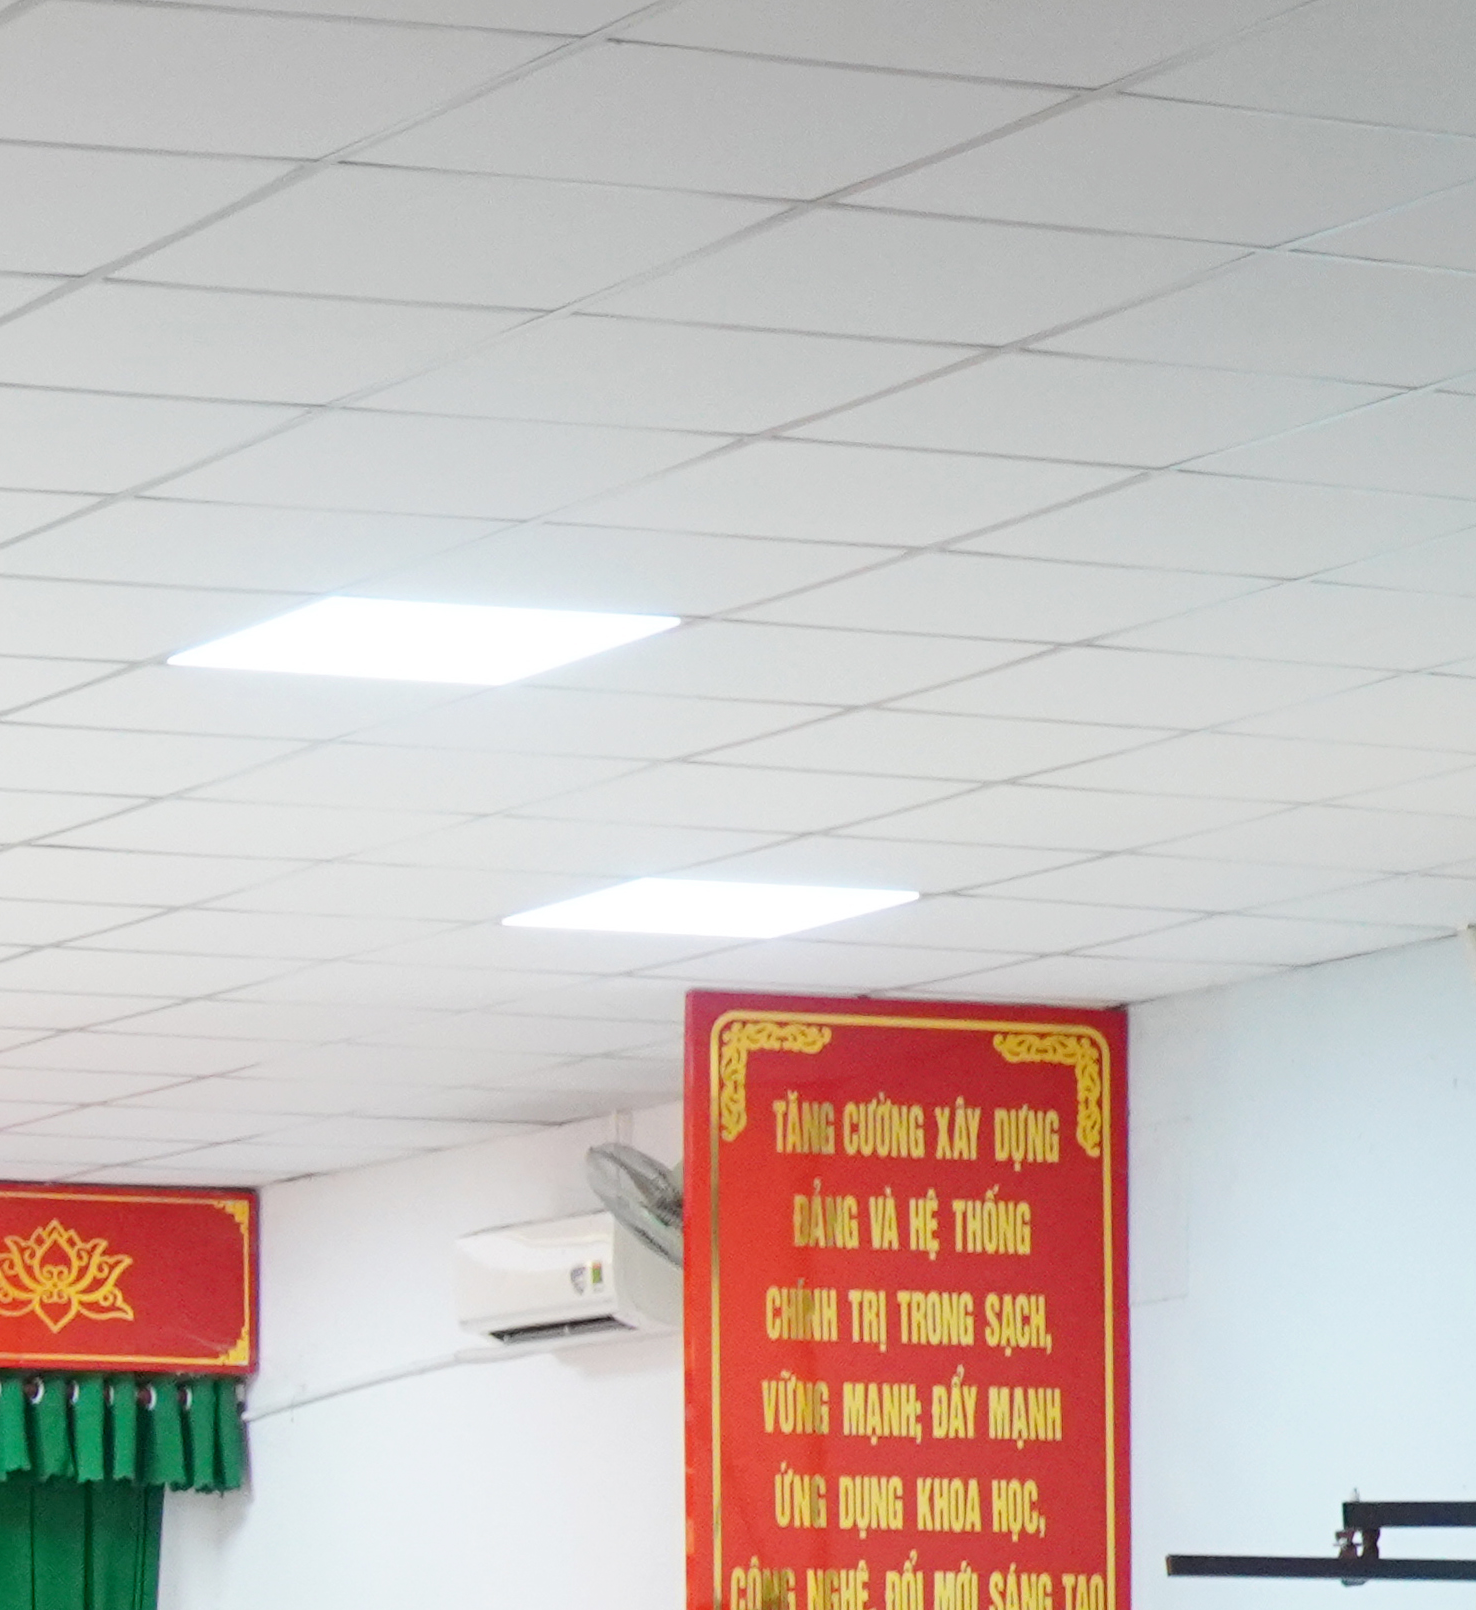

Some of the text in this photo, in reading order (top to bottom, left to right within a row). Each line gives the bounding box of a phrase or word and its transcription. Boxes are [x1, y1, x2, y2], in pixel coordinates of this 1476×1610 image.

[772, 1091, 1060, 1171] TĂNG CƯỜNG XÂY DỰNG
[793, 1178, 1031, 1260] ĐẢNG VÀ HỆ THỐNG
[765, 1279, 1052, 1356] CHÍNH TRỊ TRONG SẠCH,
[762, 1364, 1062, 1450] VỮNG MẠNH; ĐẨY MẠNH
[774, 1462, 1046, 1542] ỨNG DỤNG KHOA HỌC,
